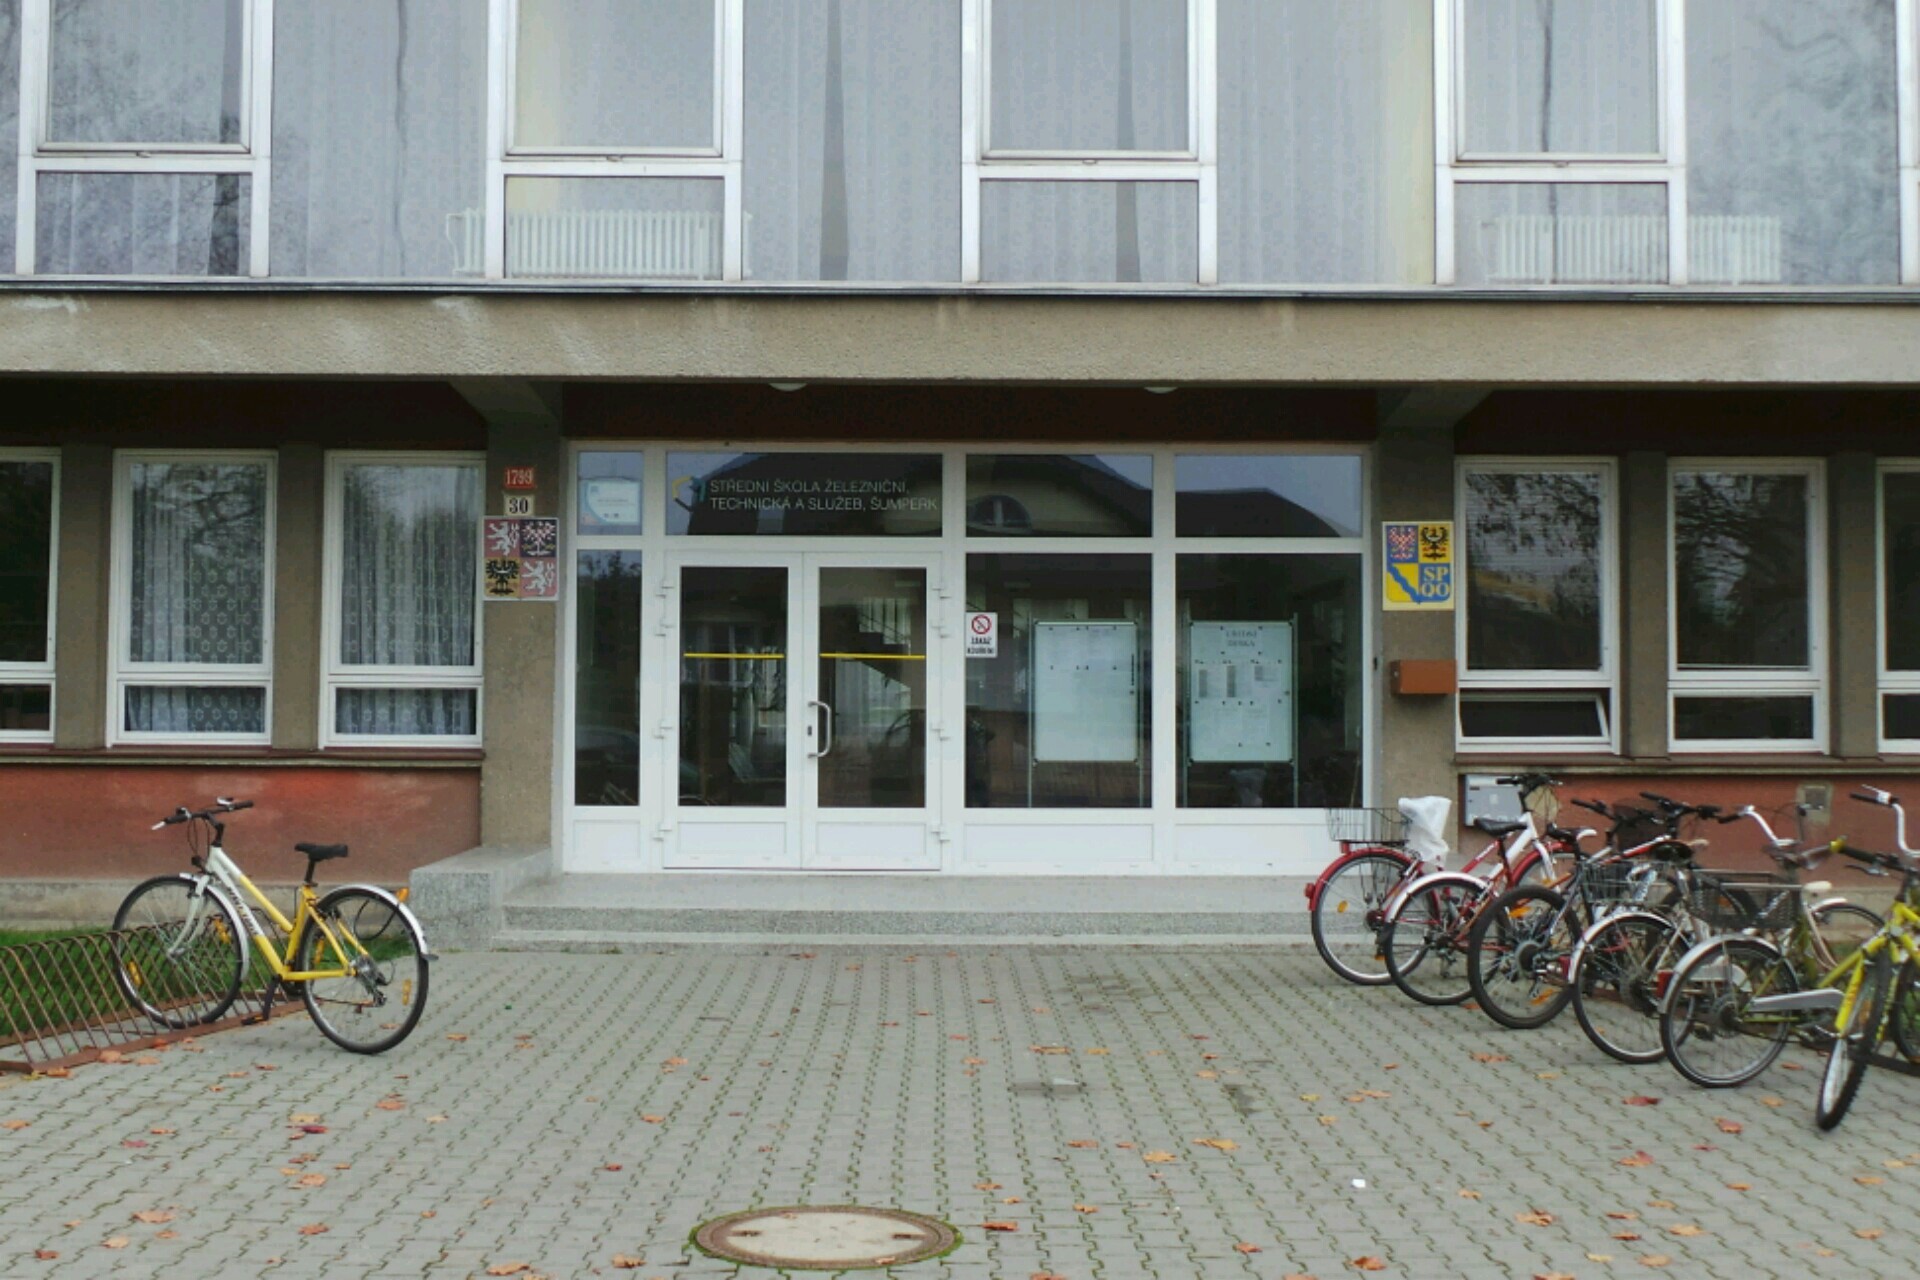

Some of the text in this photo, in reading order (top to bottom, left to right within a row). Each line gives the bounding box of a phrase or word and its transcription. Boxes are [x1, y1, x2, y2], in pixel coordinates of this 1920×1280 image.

[710, 477, 910, 494] STŘEDNÍ ŠKOLA ŽELEZNIČNÍ,
[509, 497, 528, 514] 30
[710, 495, 938, 512] TECHNICKÁ A SLUŽEB, ŠUMPERK
[1424, 566, 1449, 581] SP
